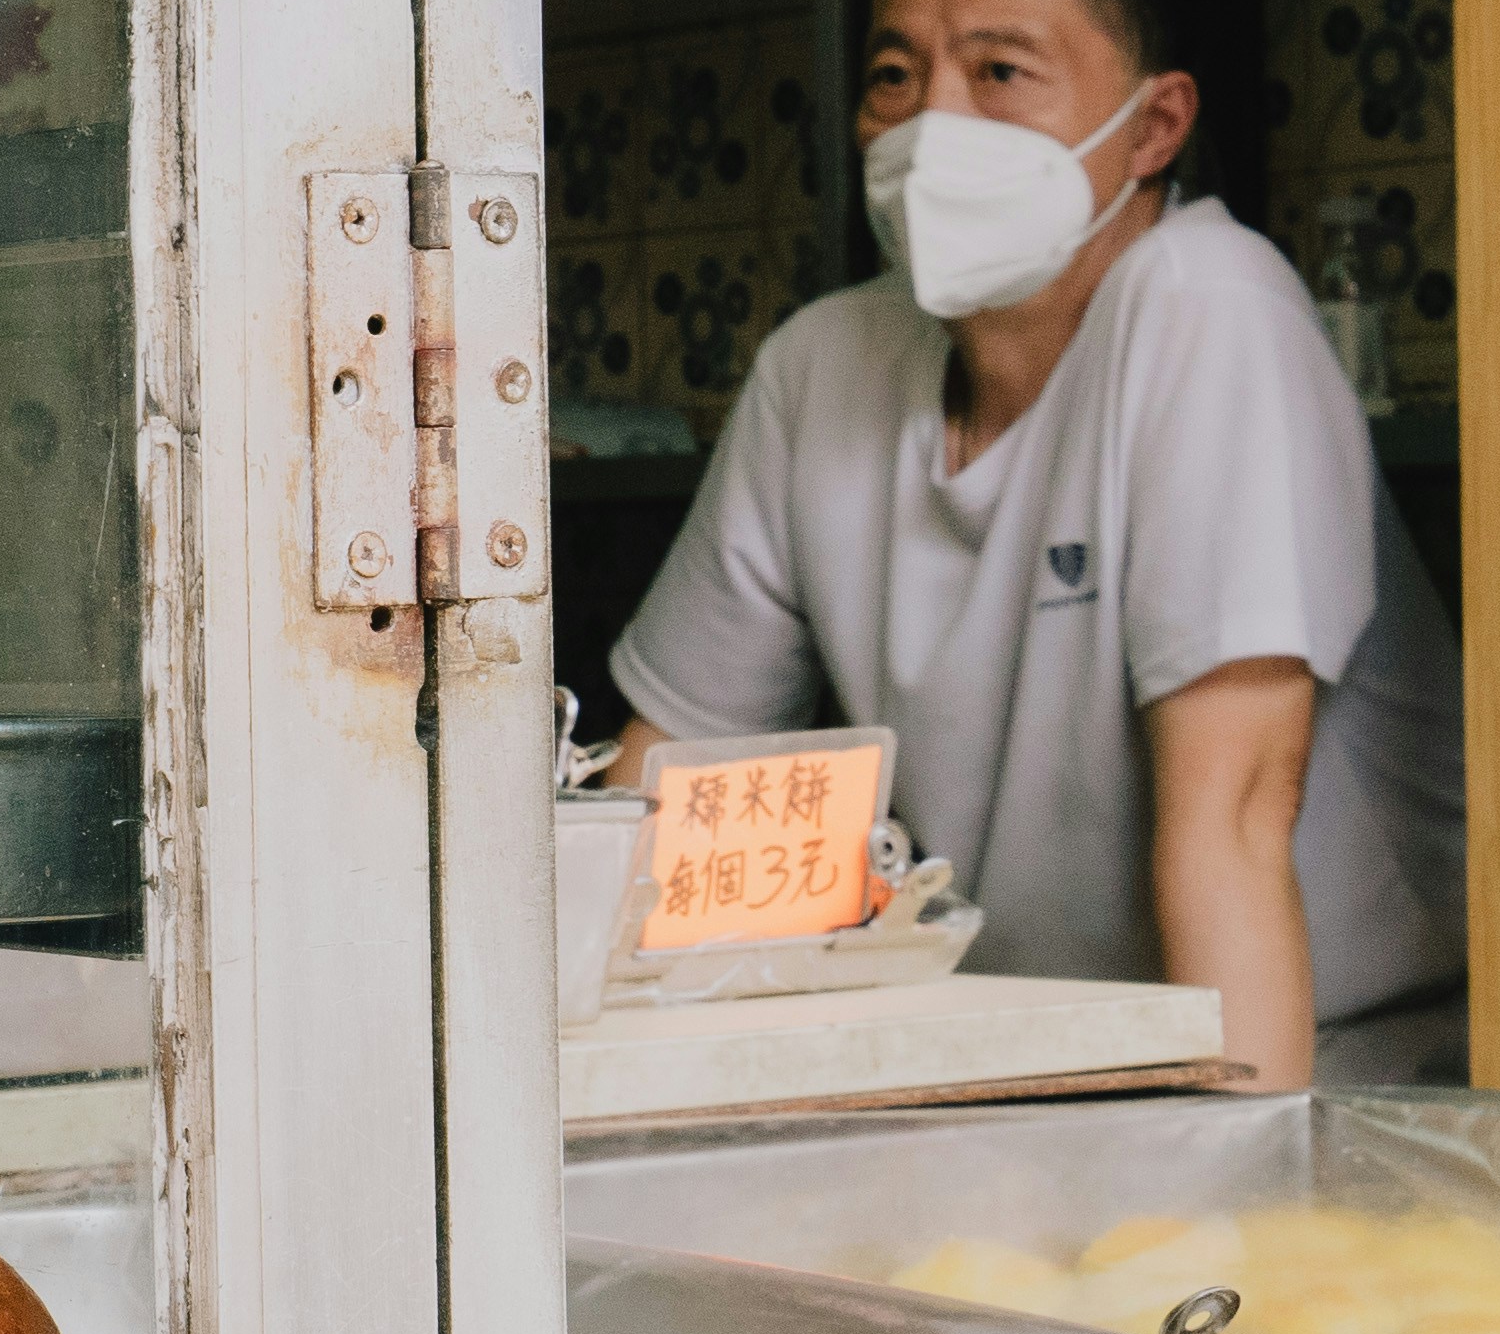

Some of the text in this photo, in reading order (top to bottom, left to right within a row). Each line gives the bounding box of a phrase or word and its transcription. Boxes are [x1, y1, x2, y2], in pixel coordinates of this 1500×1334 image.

[680, 758, 832, 840] 糯米餅
[666, 839, 837, 916] 每個3元
